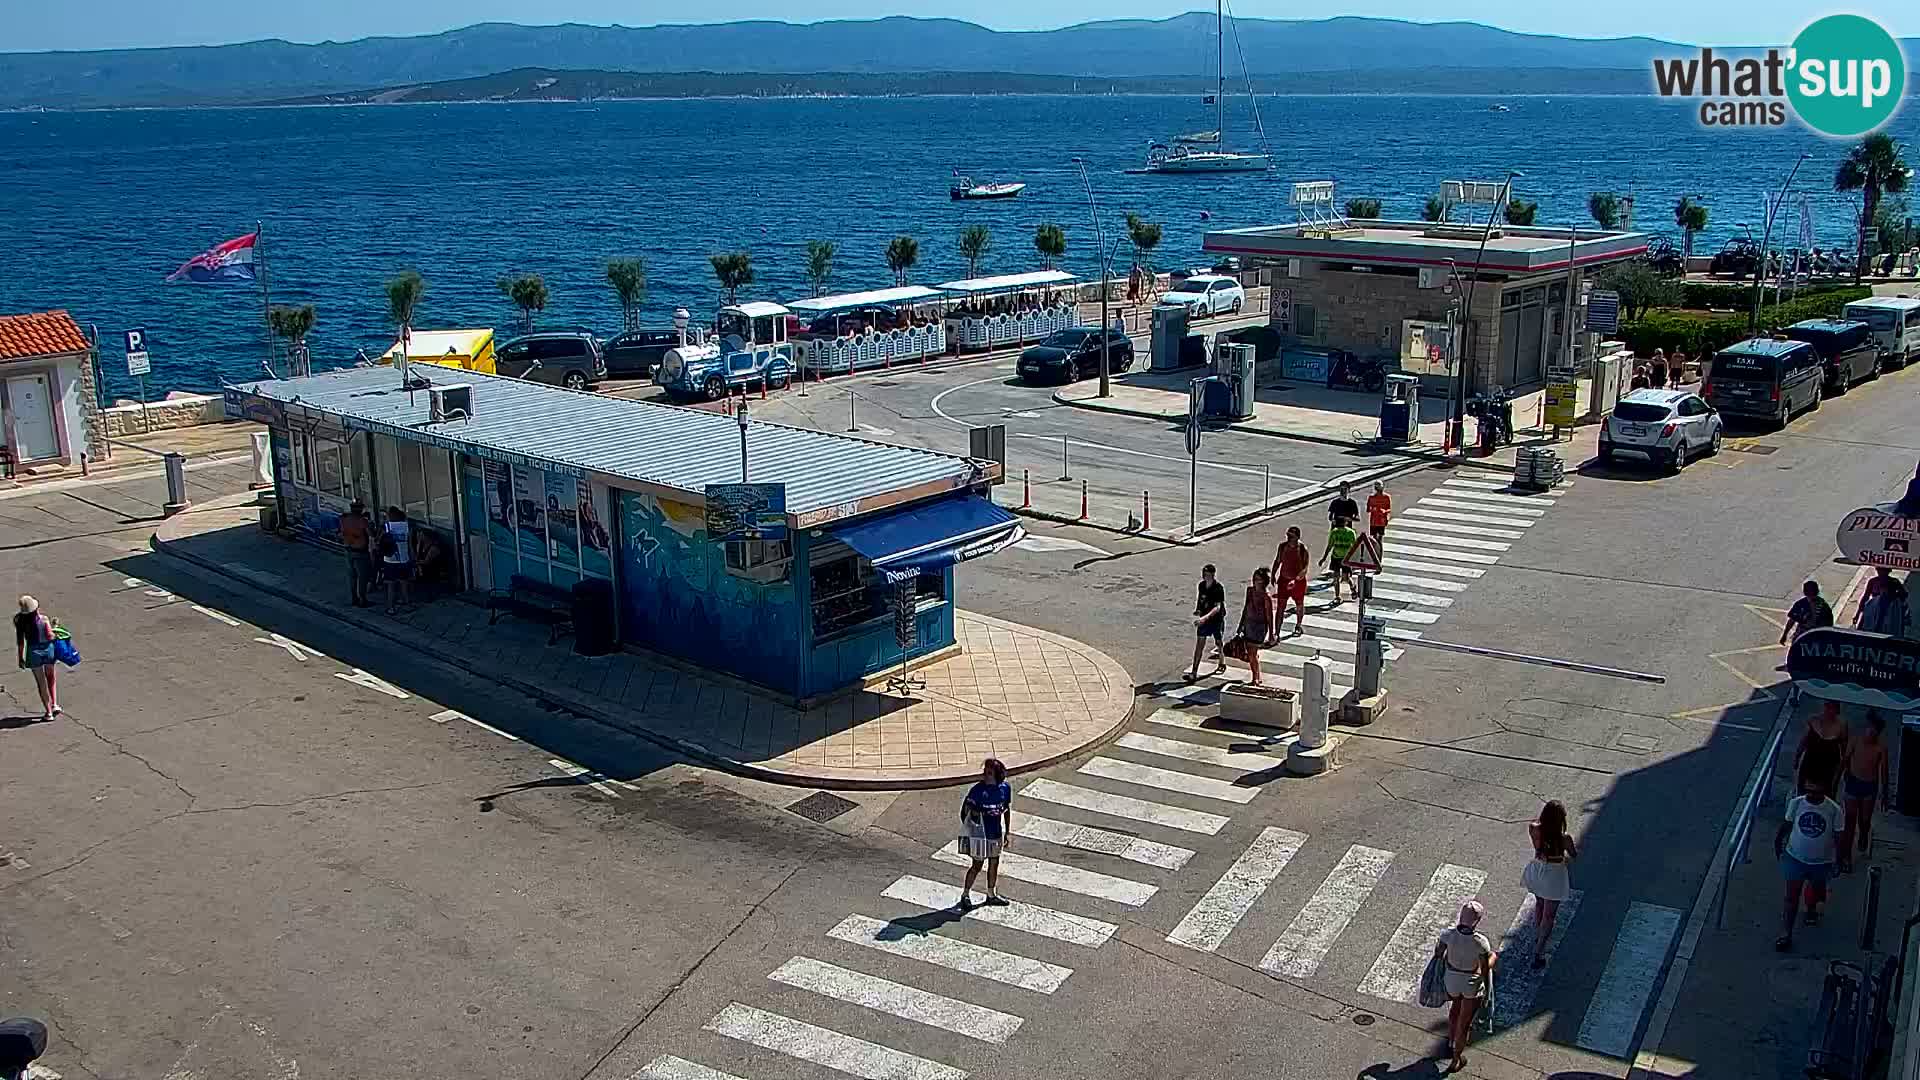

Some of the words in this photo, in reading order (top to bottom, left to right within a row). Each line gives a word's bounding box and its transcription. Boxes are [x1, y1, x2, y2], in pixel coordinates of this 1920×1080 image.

[128, 332, 142, 350] P
[1736, 357, 1755, 365] TAXI
[477, 447, 492, 458] BUS
[493, 450, 525, 465] STATION
[528, 457, 553, 472] TICKET
[554, 463, 582, 477] OFFICE
[1848, 514, 1920, 533] PIZZE
[1869, 664, 1897, 680] bar
